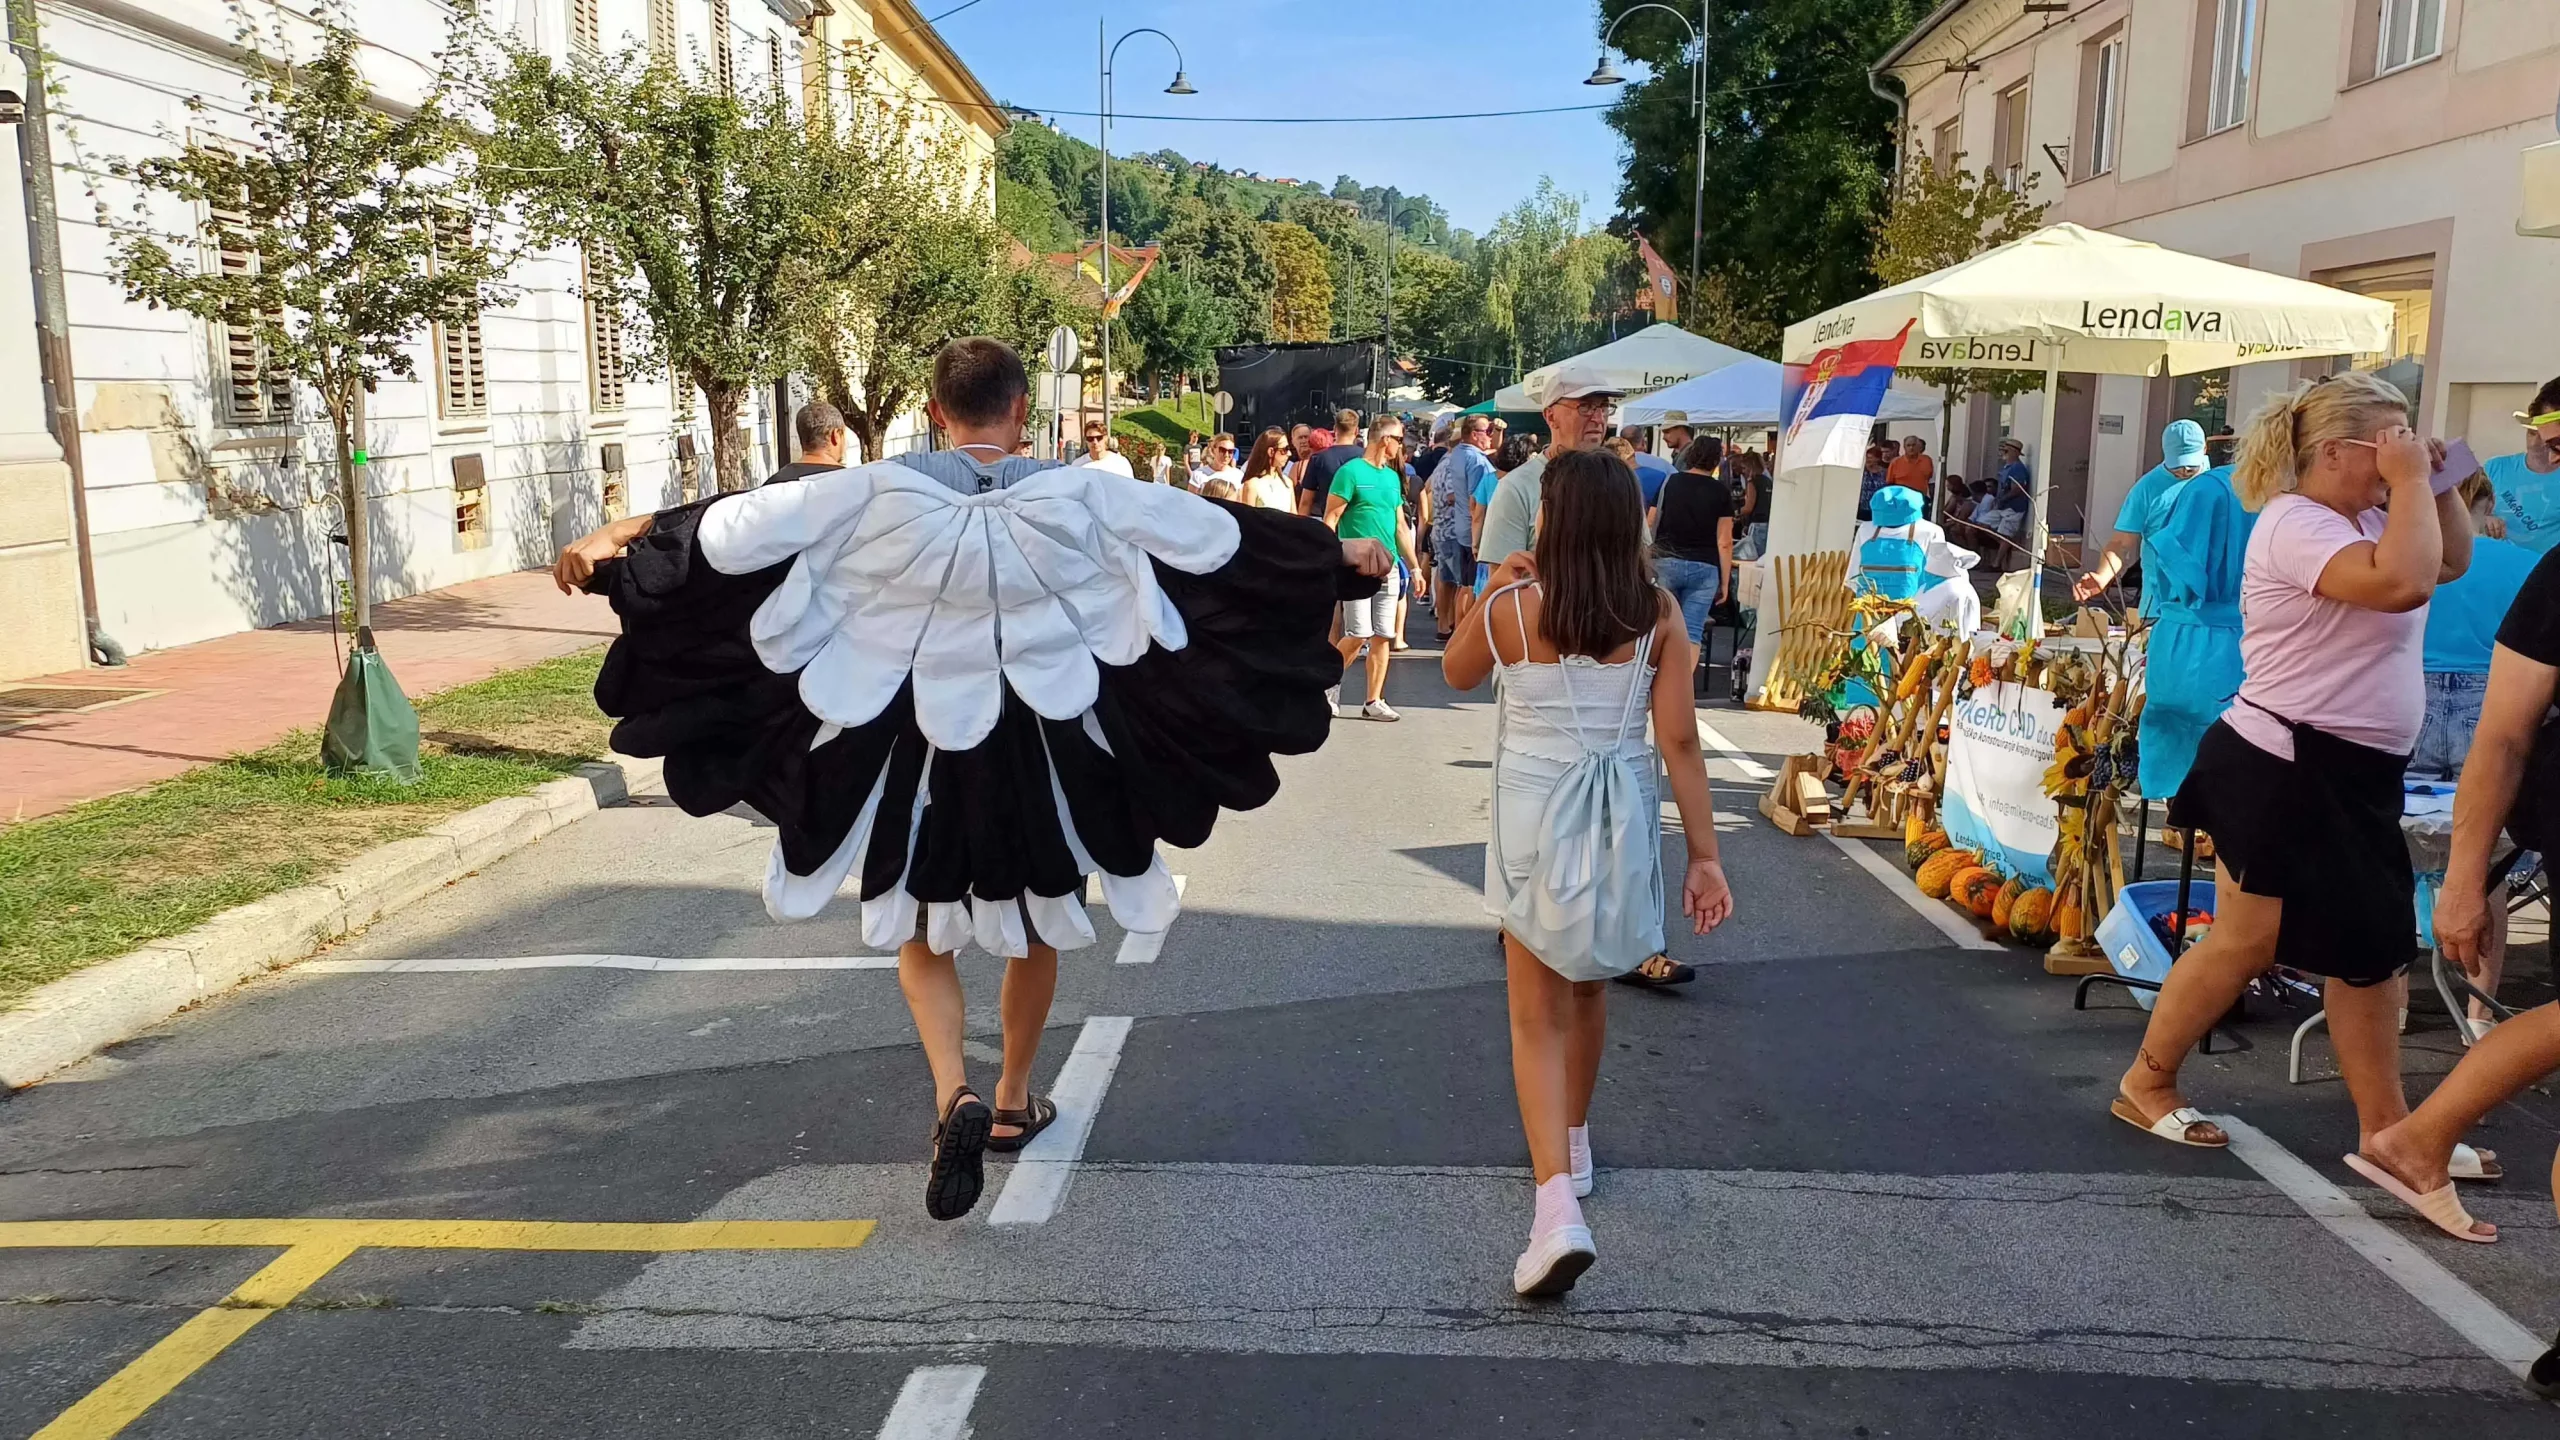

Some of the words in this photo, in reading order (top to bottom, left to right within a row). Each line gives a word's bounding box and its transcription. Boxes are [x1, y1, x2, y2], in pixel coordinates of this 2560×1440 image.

[1812, 313, 1855, 344] Lendava
[2080, 300, 2222, 333] Lendava
[1988, 796, 2055, 830] info@mikero-cad.si
